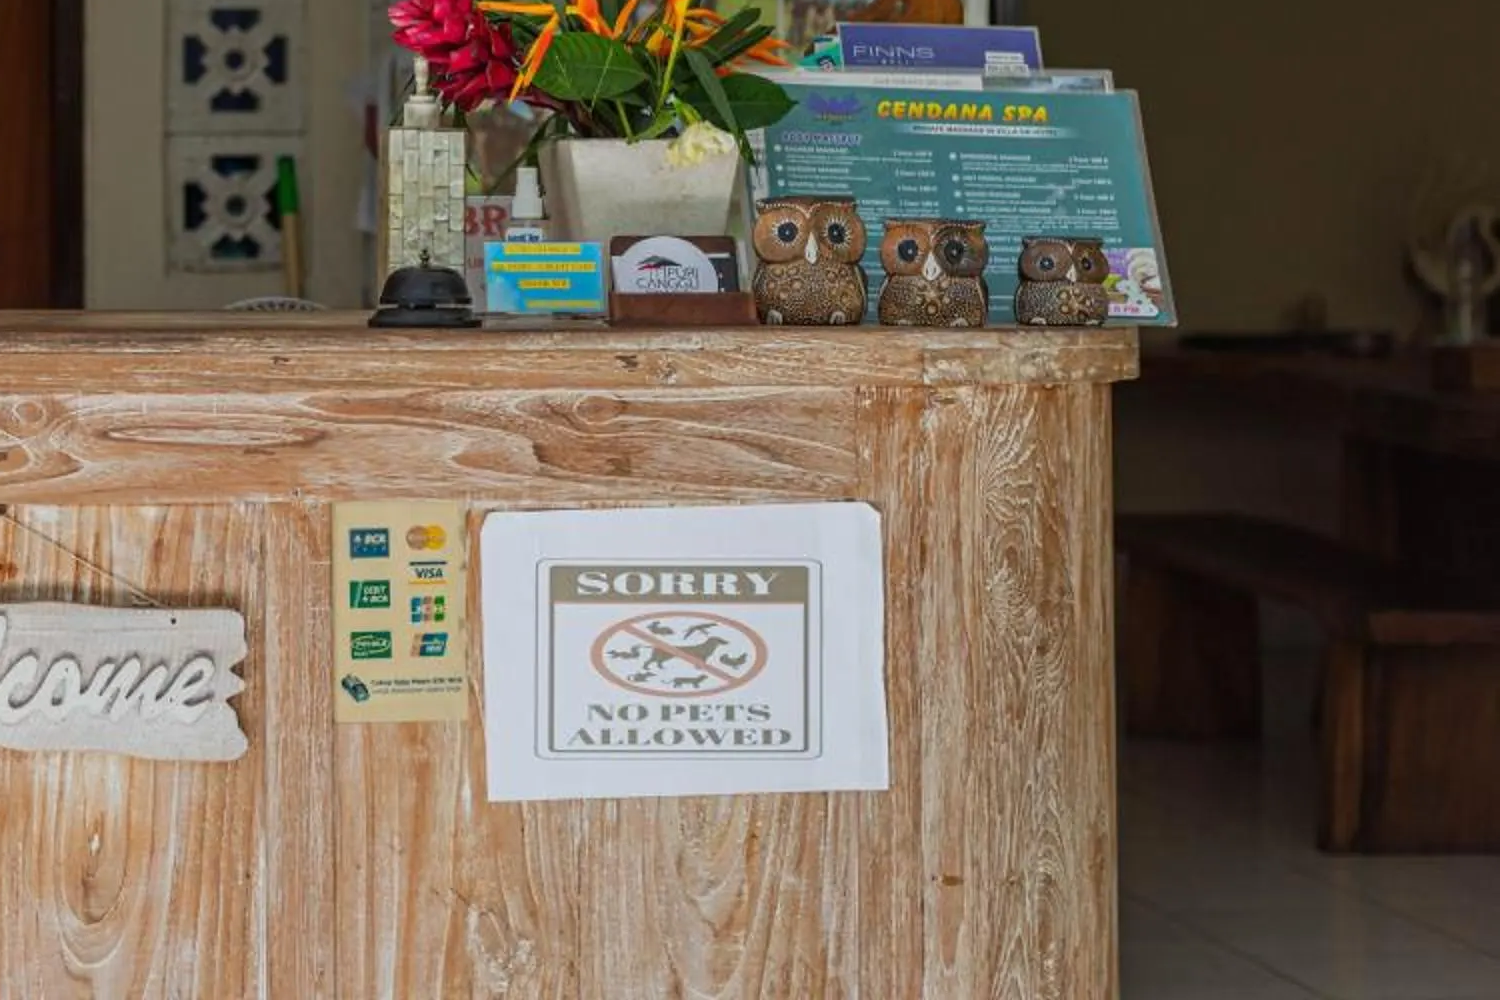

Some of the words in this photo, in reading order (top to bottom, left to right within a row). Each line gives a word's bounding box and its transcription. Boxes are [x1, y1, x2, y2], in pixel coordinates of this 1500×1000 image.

[853, 45, 935, 59] FINNS
[877, 99, 993, 121] CENDANA
[1003, 104, 1048, 121] SPA
[415, 567, 444, 579] VISA
[575, 571, 783, 597] SORRY
[586, 703, 650, 722] NO
[660, 703, 773, 722] PETS
[566, 727, 792, 747] ALLOWED
